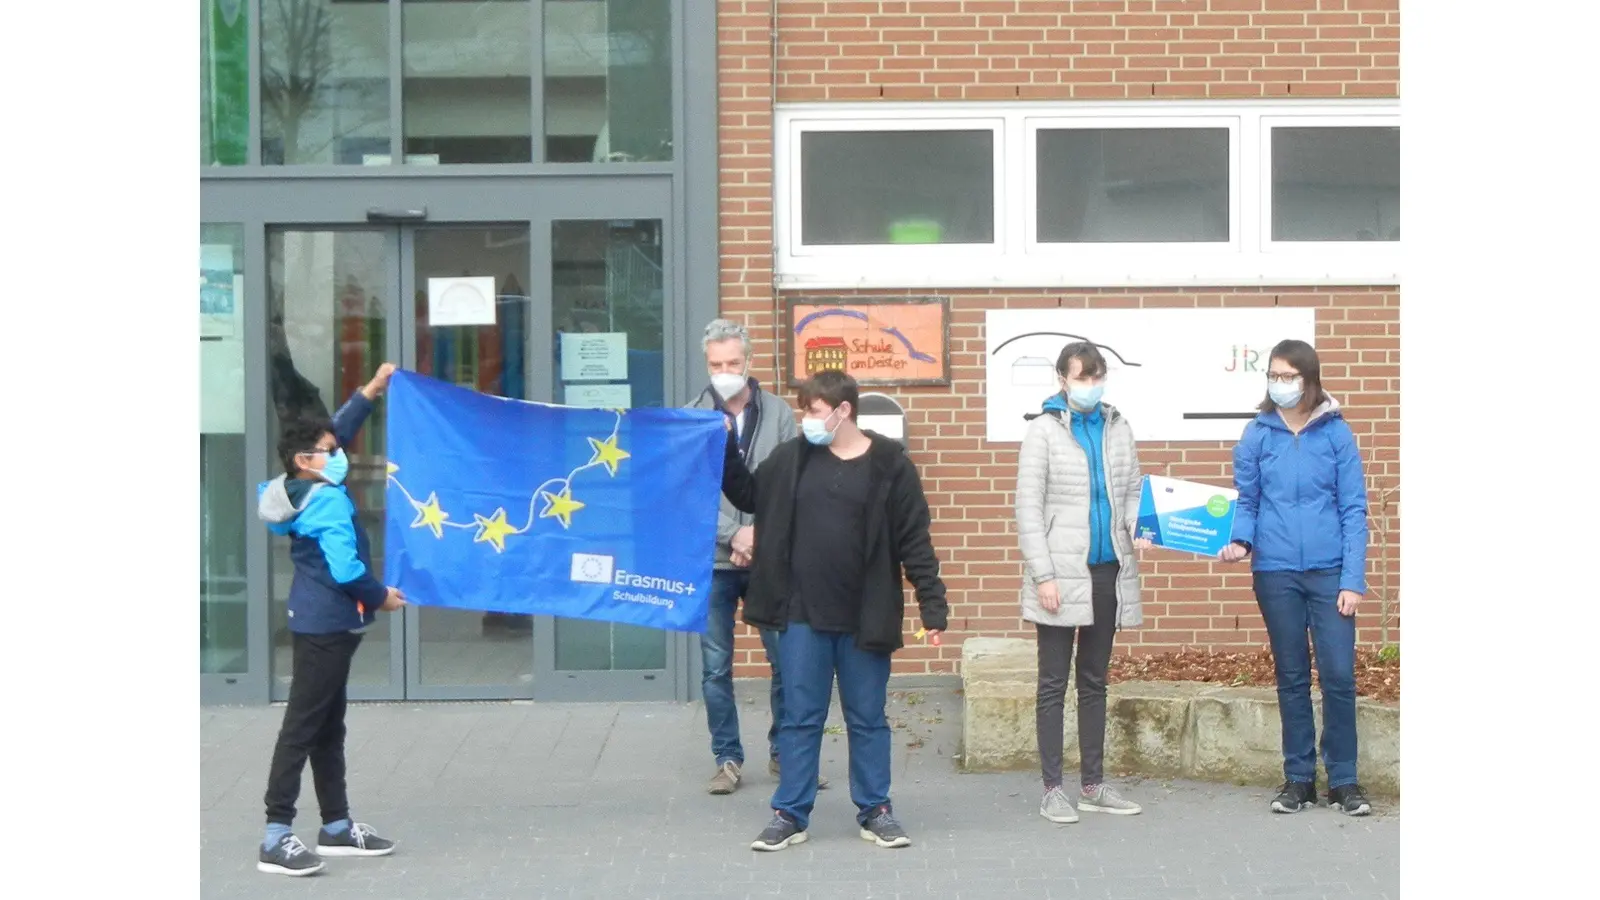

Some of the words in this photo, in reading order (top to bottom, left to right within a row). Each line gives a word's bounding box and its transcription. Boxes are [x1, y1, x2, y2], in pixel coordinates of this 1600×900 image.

[851, 337, 893, 354] Schule
[867, 355, 908, 370] Deister
[614, 569, 697, 596] Erasmus+
[612, 590, 675, 610] Schulbildung
